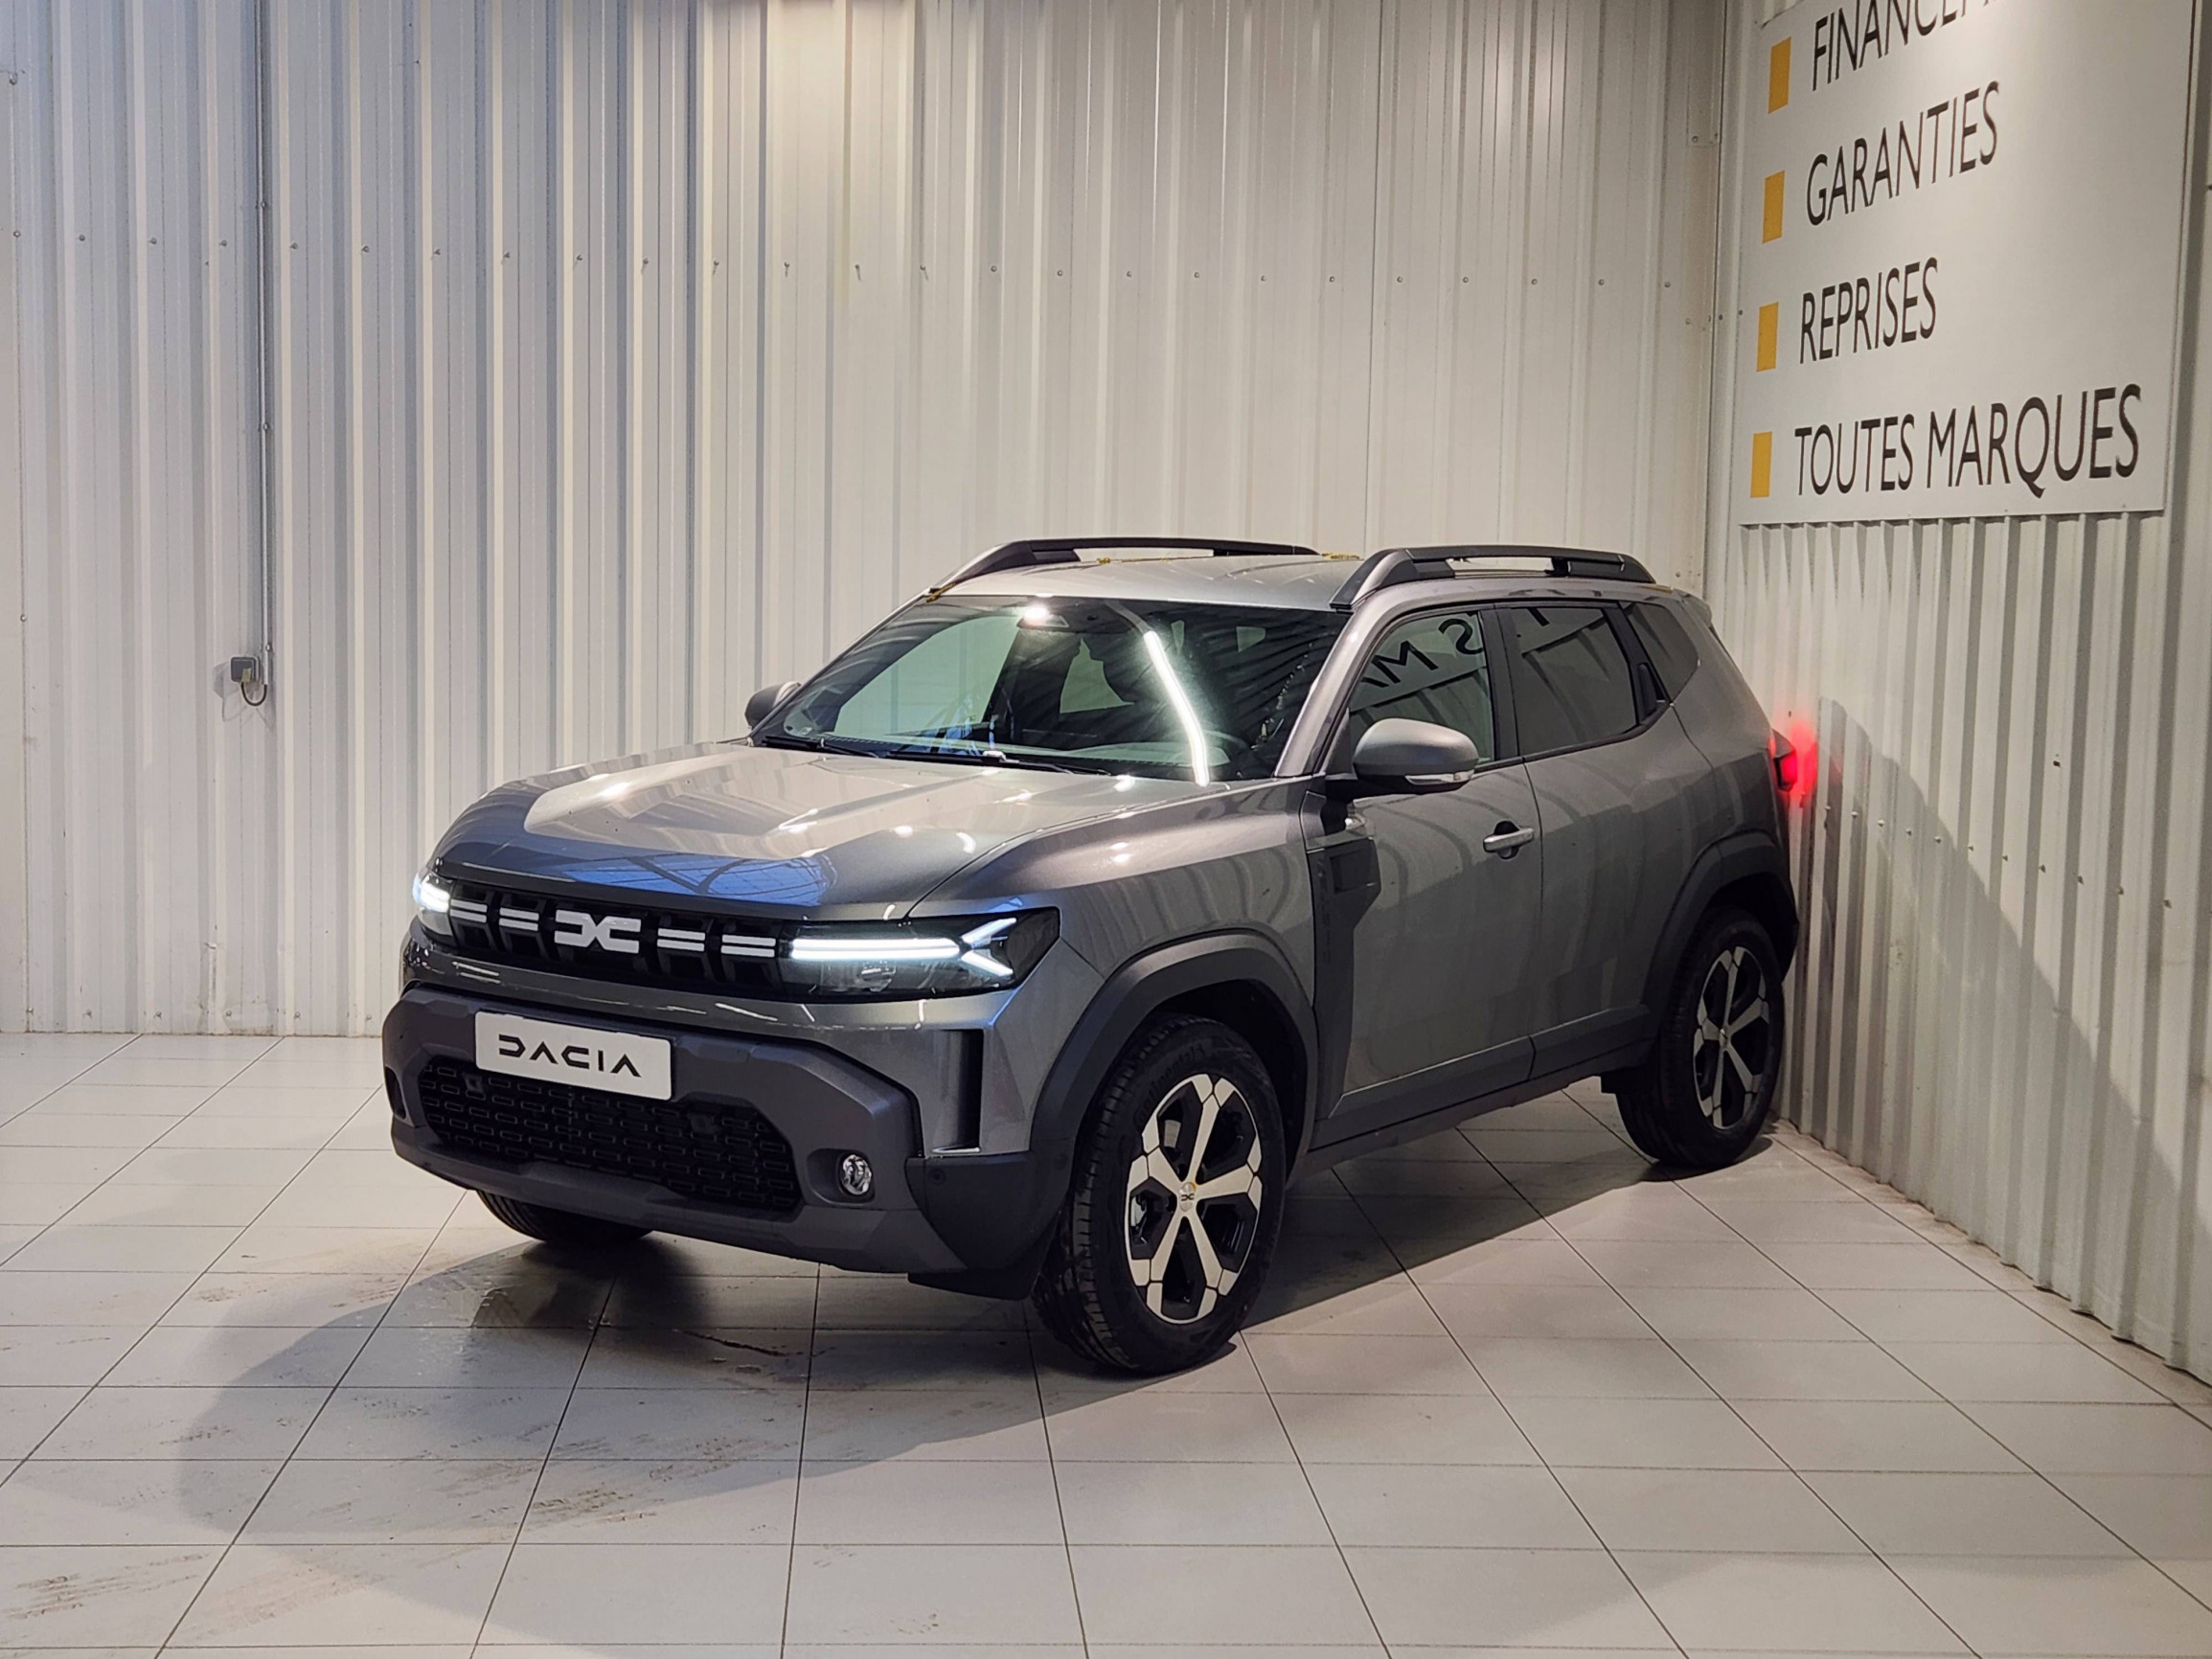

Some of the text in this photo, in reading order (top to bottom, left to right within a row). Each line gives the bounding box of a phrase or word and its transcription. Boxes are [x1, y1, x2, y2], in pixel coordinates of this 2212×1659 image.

[1806, 80, 1999, 226] GARANTIES
[1799, 257, 1938, 365] REPRISES
[1794, 383, 2142, 499] TOUTES MARQUES
[498, 1034, 642, 1079] DACIA
